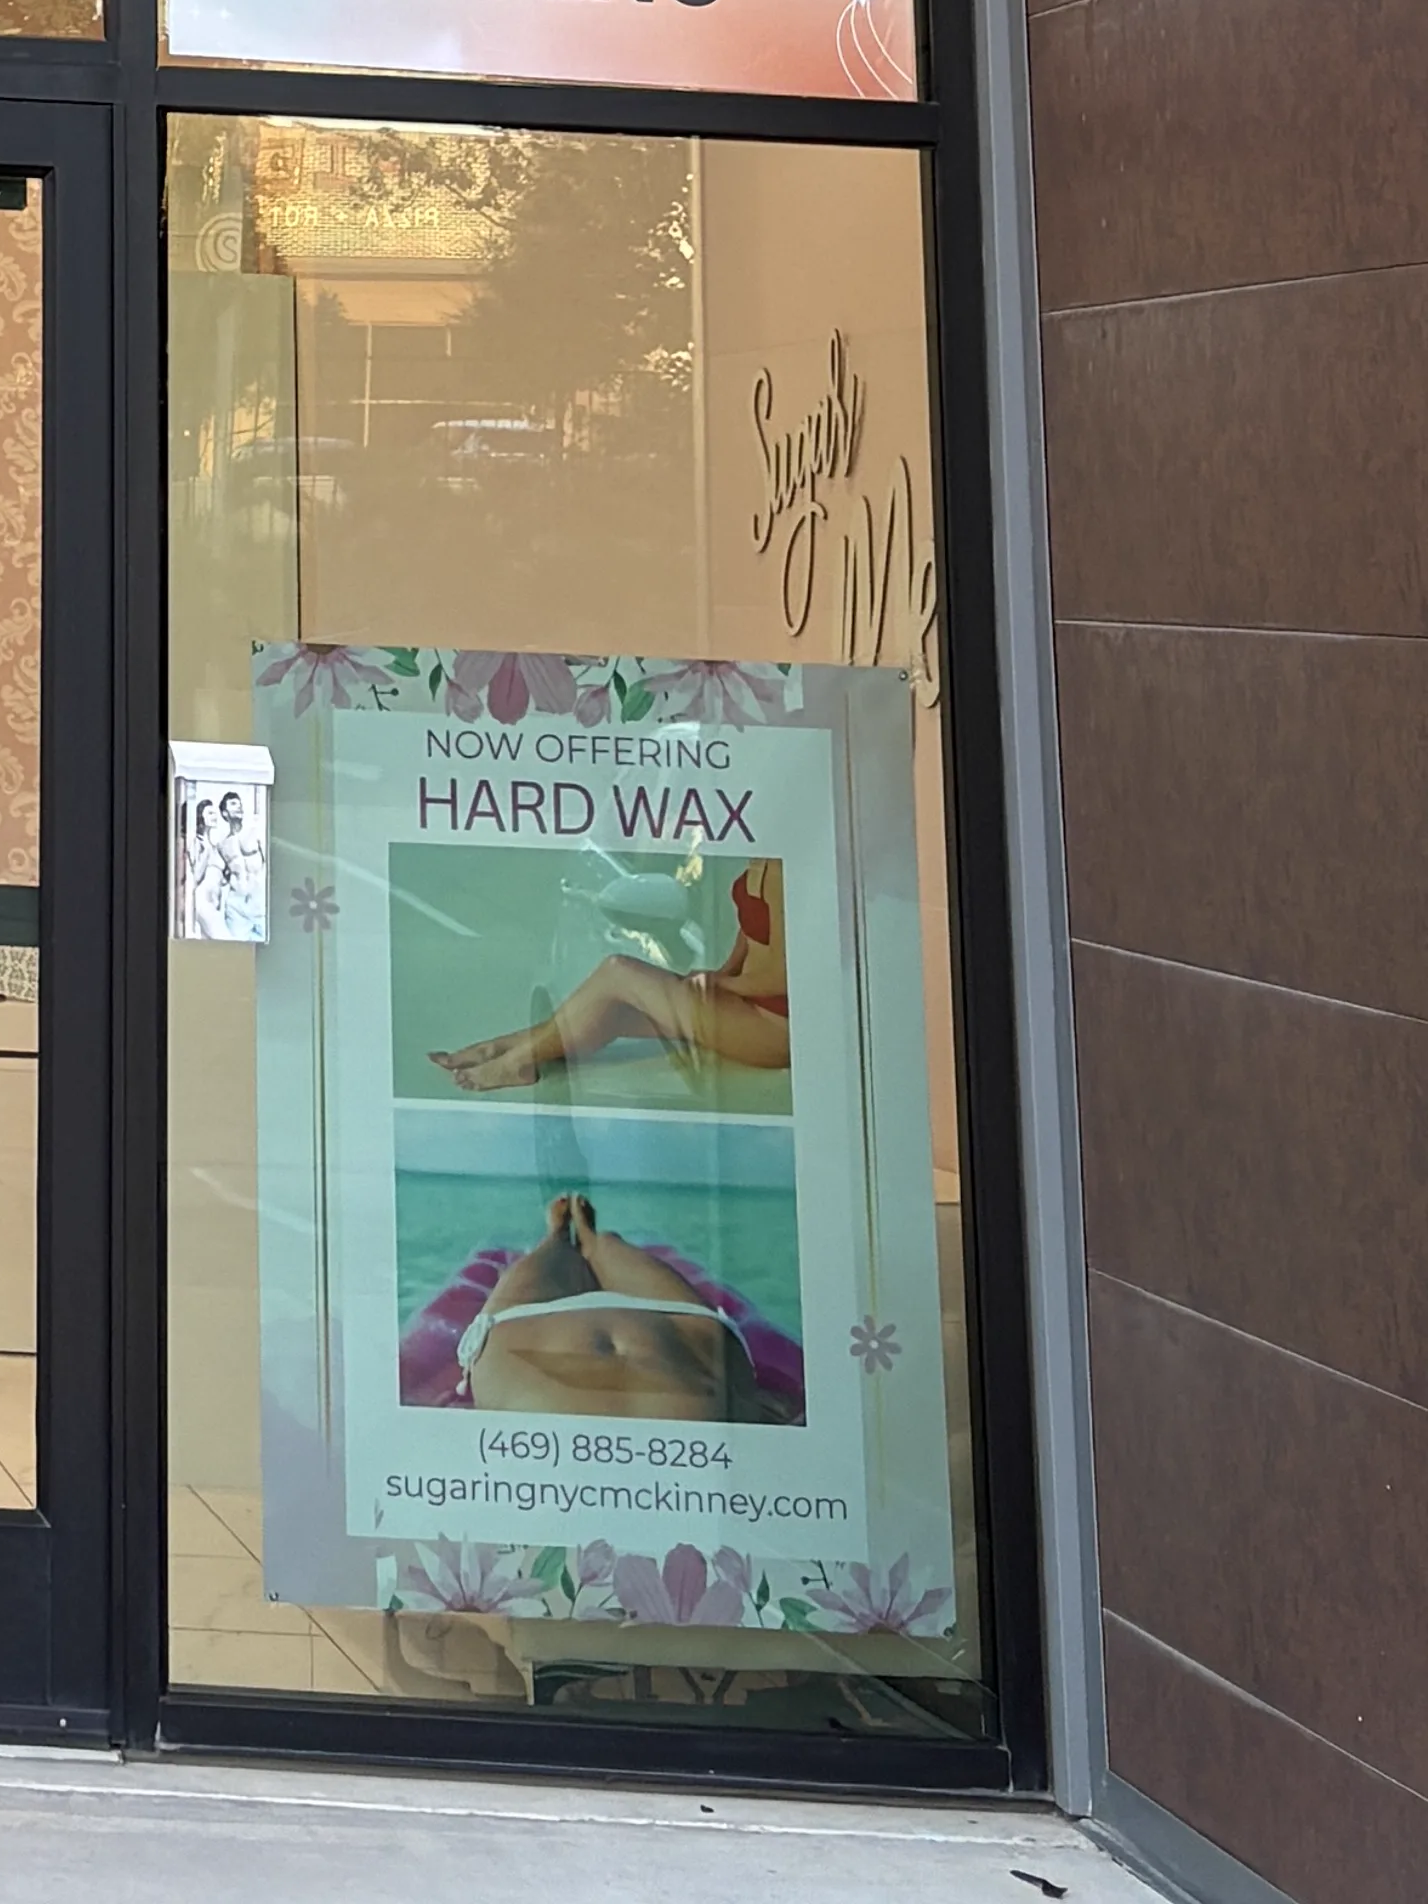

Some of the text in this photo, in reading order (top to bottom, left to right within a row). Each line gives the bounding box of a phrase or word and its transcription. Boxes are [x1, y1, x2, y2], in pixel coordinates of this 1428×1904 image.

[424, 727, 732, 770] NOW OFFERING
[417, 775, 756, 844] HARD WAX
[477, 1428, 734, 1472] (469) 885-8284
[385, 1471, 848, 1524] sugaringnycmckinney.com
